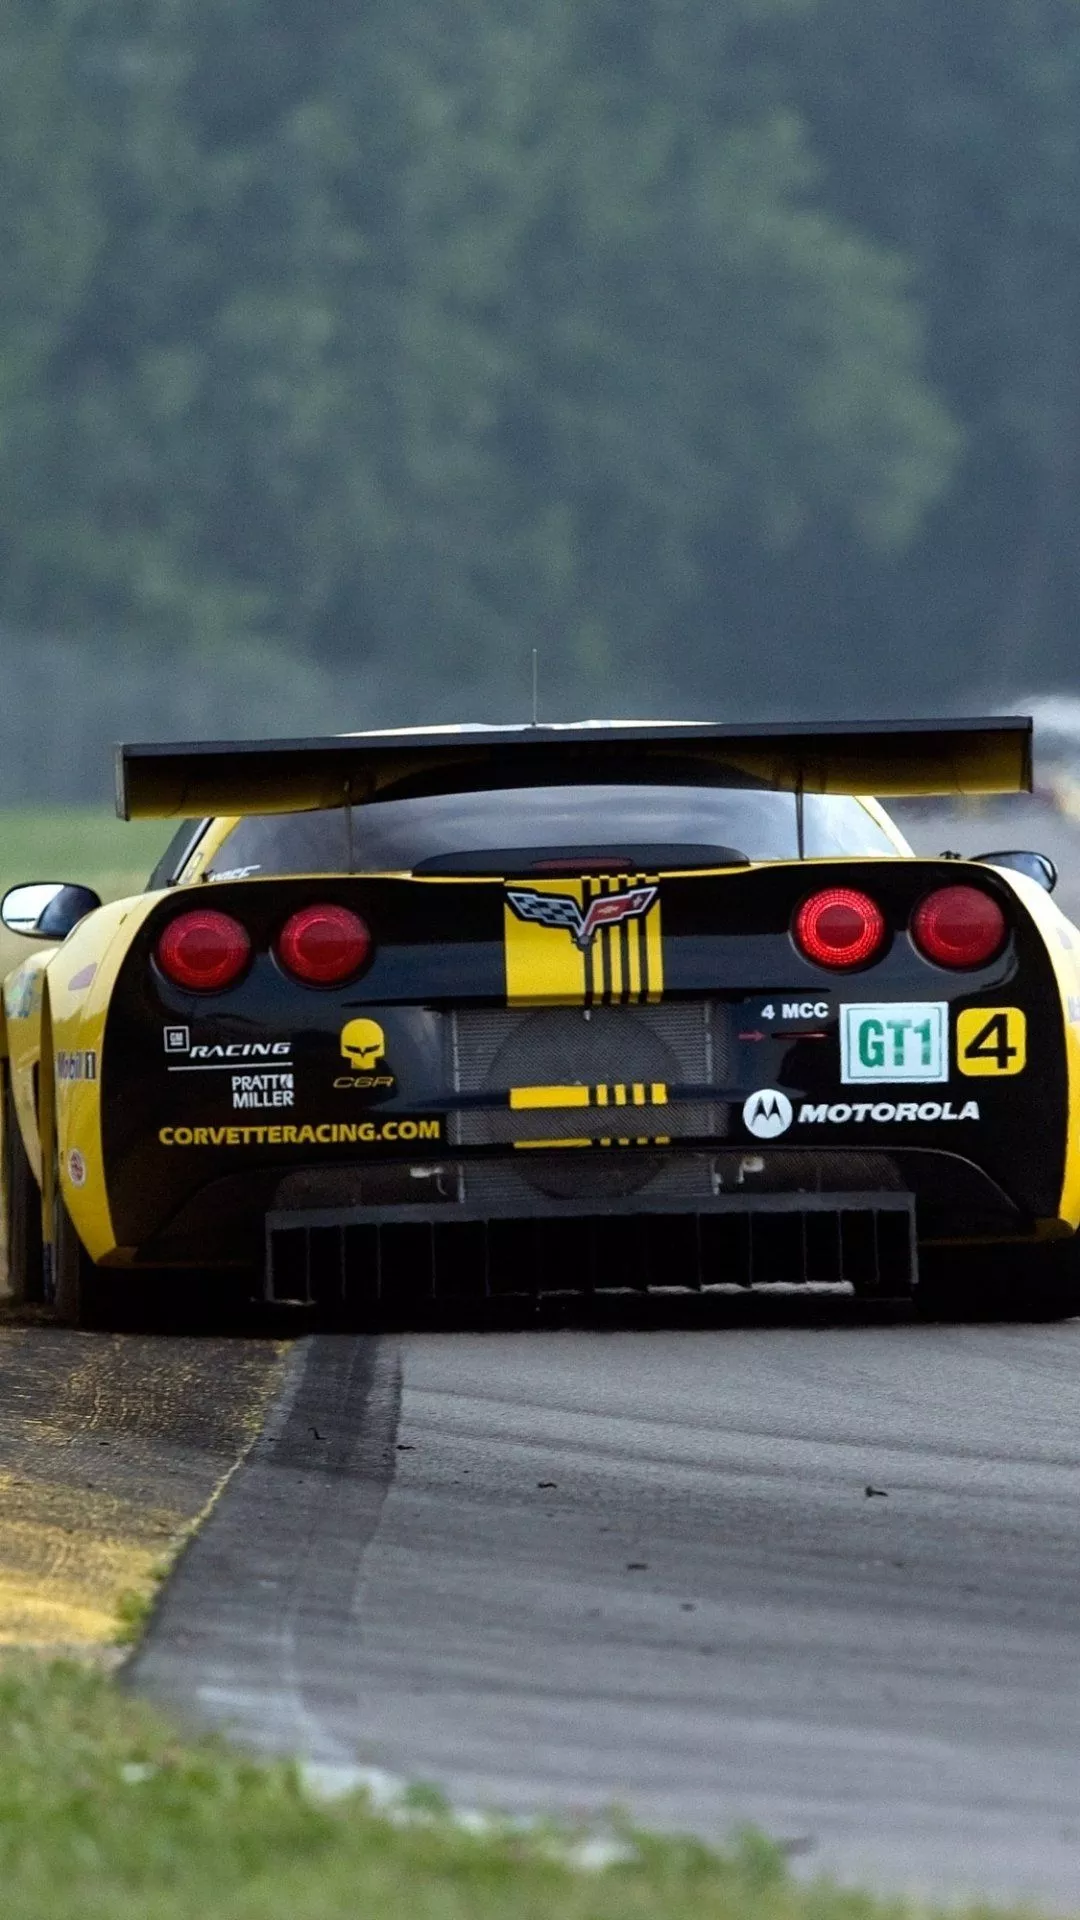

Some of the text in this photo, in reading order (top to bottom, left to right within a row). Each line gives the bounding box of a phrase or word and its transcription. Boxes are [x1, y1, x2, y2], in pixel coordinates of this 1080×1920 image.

[761, 1002, 828, 1019] 4 MCC
[189, 1042, 292, 1058] RACING
[858, 1018, 932, 1068] GT1
[964, 1013, 1017, 1069] 4
[231, 1074, 281, 1091] PRATT
[232, 1090, 294, 1109] MILLER
[798, 1101, 980, 1123] MOTOROLA
[158, 1121, 440, 1145] CORVETTERACING.COM
